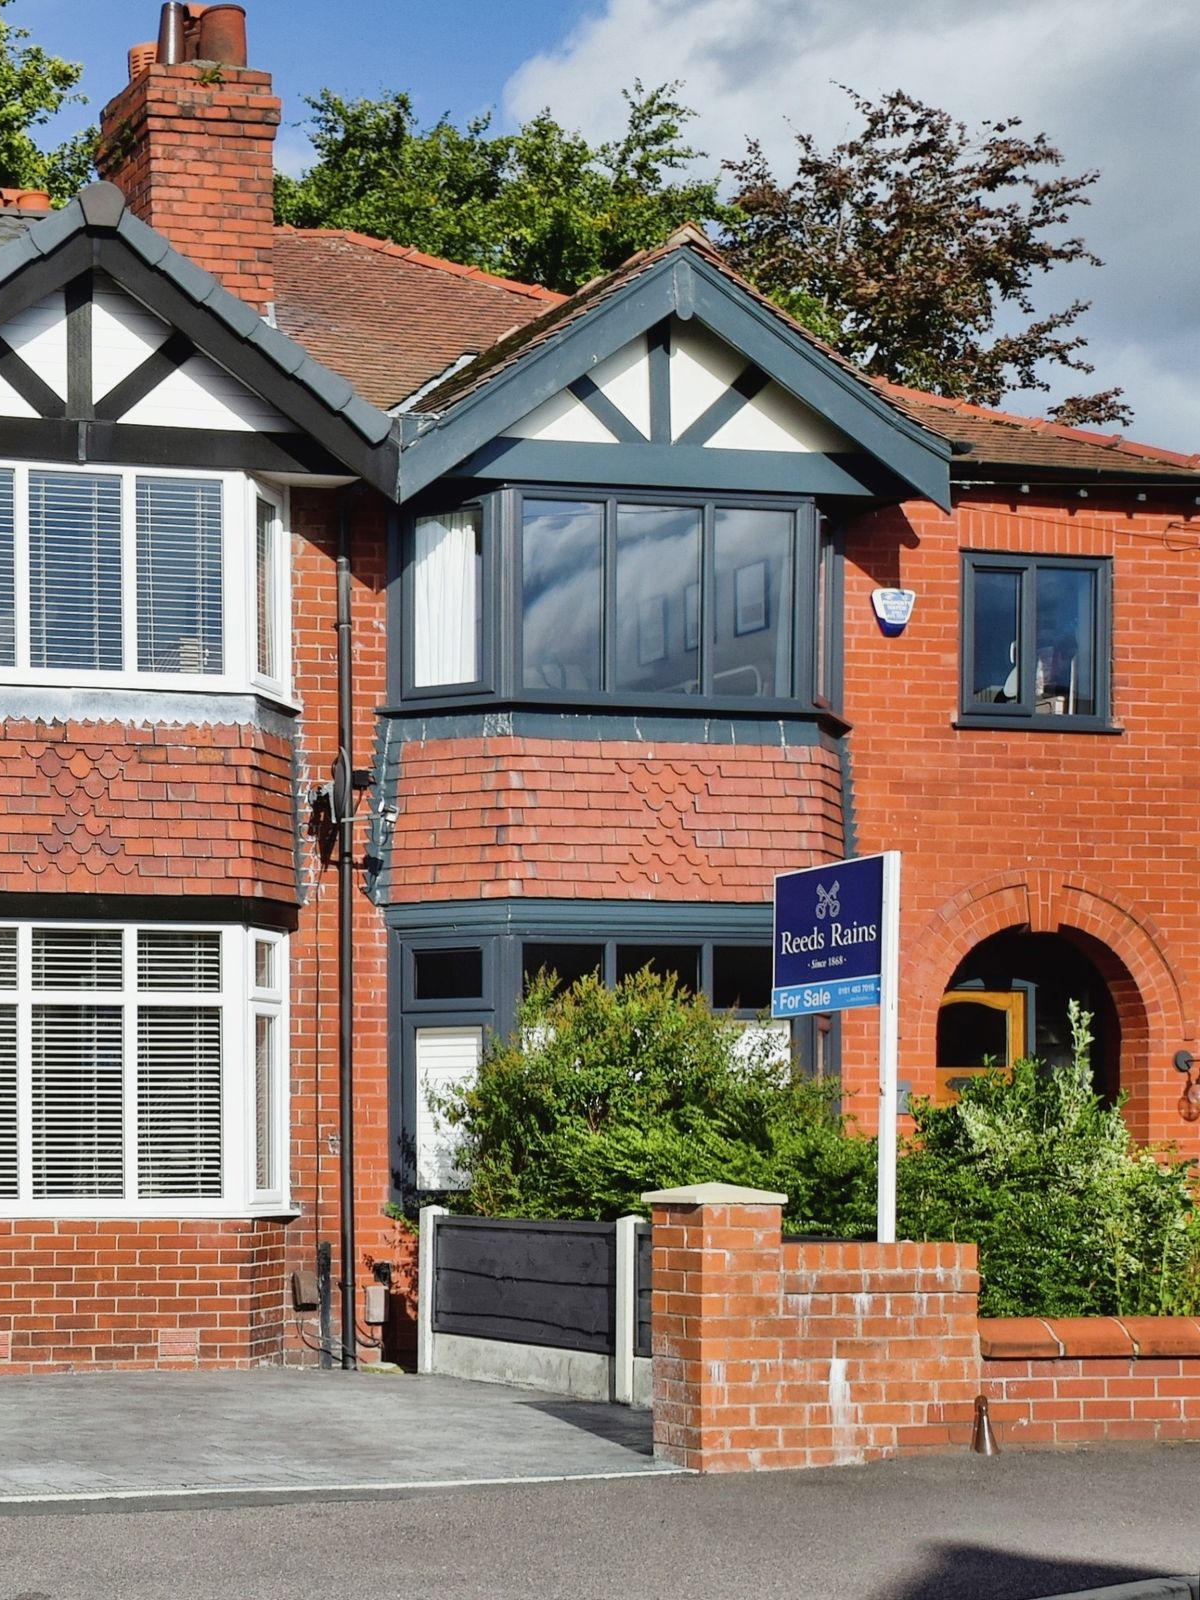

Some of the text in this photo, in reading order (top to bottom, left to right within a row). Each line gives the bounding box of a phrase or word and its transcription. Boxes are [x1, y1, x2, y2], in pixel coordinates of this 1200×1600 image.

[781, 921, 877, 955] Reeds Rains
[811, 959, 827, 969] Since
[780, 988, 831, 1010] For Sale
